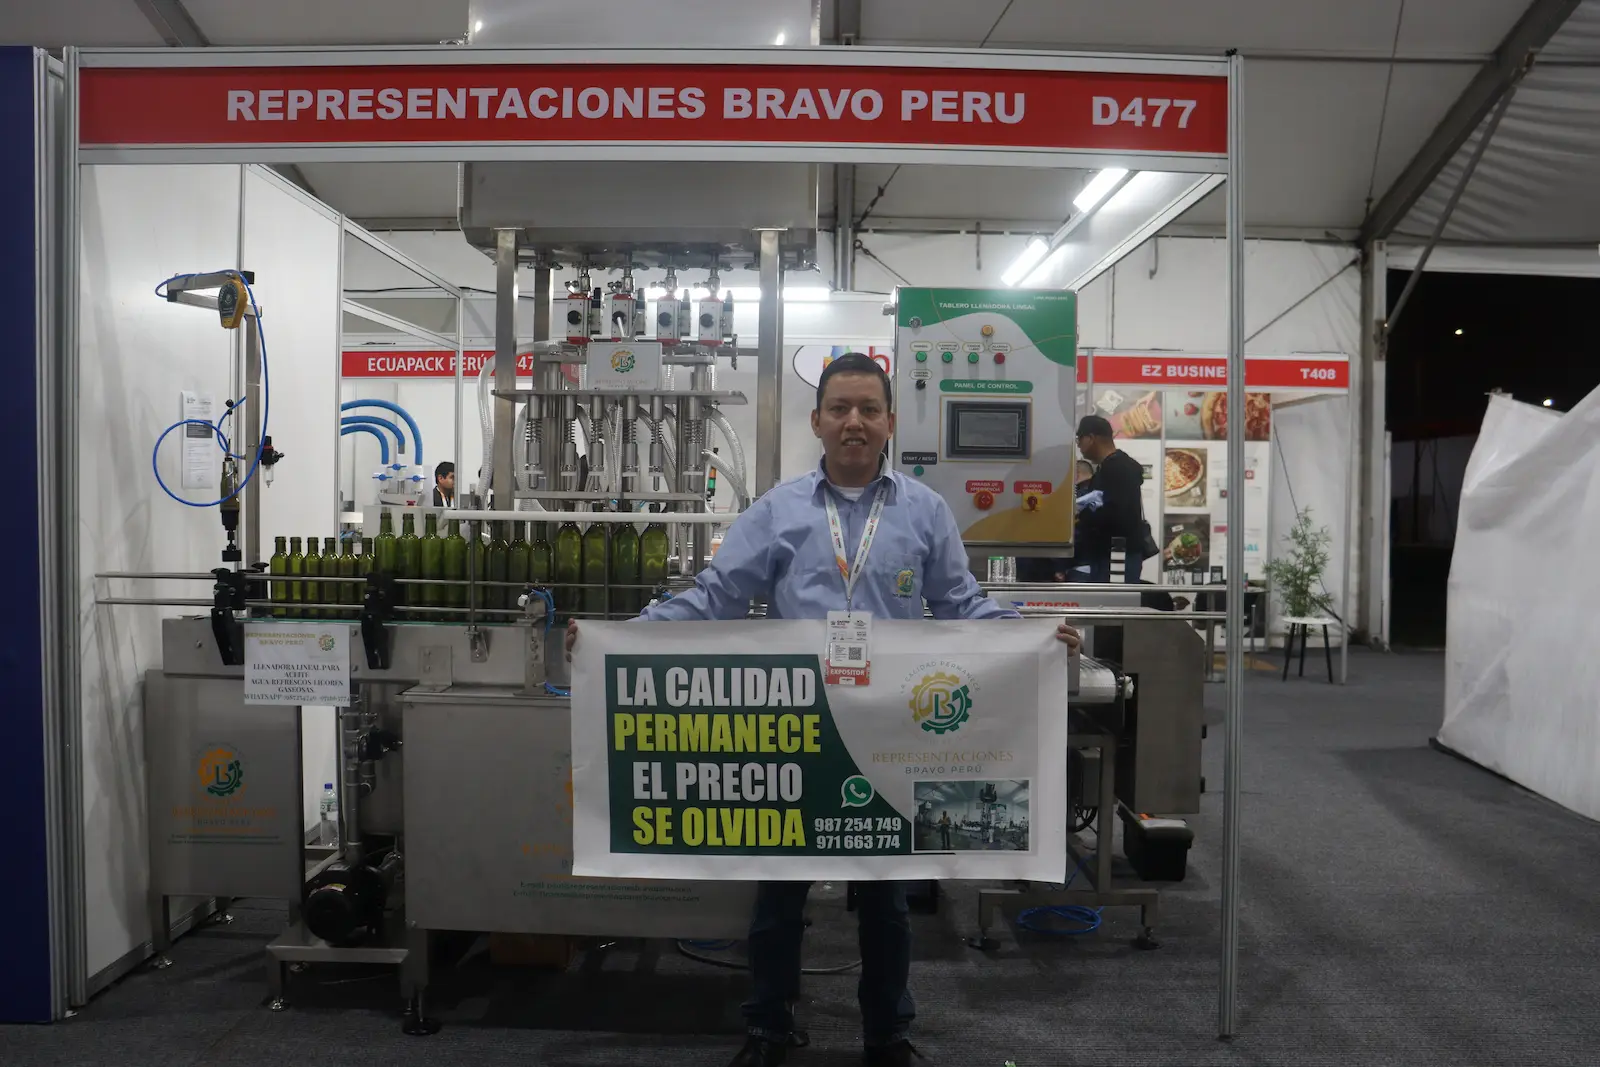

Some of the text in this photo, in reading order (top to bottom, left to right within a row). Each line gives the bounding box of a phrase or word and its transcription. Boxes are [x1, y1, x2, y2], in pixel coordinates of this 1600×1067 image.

[226, 84, 1197, 130] REPRESENTACIONES BRAVO PERU D477
[367, 356, 444, 372] ECUAPACK
[1141, 364, 1162, 377] EZ
[1300, 368, 1336, 381] T408
[284, 671, 310, 679] ACEITE
[616, 666, 816, 707] LA CALIDAD
[614, 713, 821, 753] PERMANECE
[872, 749, 1014, 763] REPRESENTACIONES
[905, 766, 945, 775] BRAVO
[632, 761, 803, 802] EL PRECIO
[632, 806, 806, 847] SE OLVIDA
[814, 816, 902, 832] 987 254 749
[816, 834, 901, 850] 971 663 774
